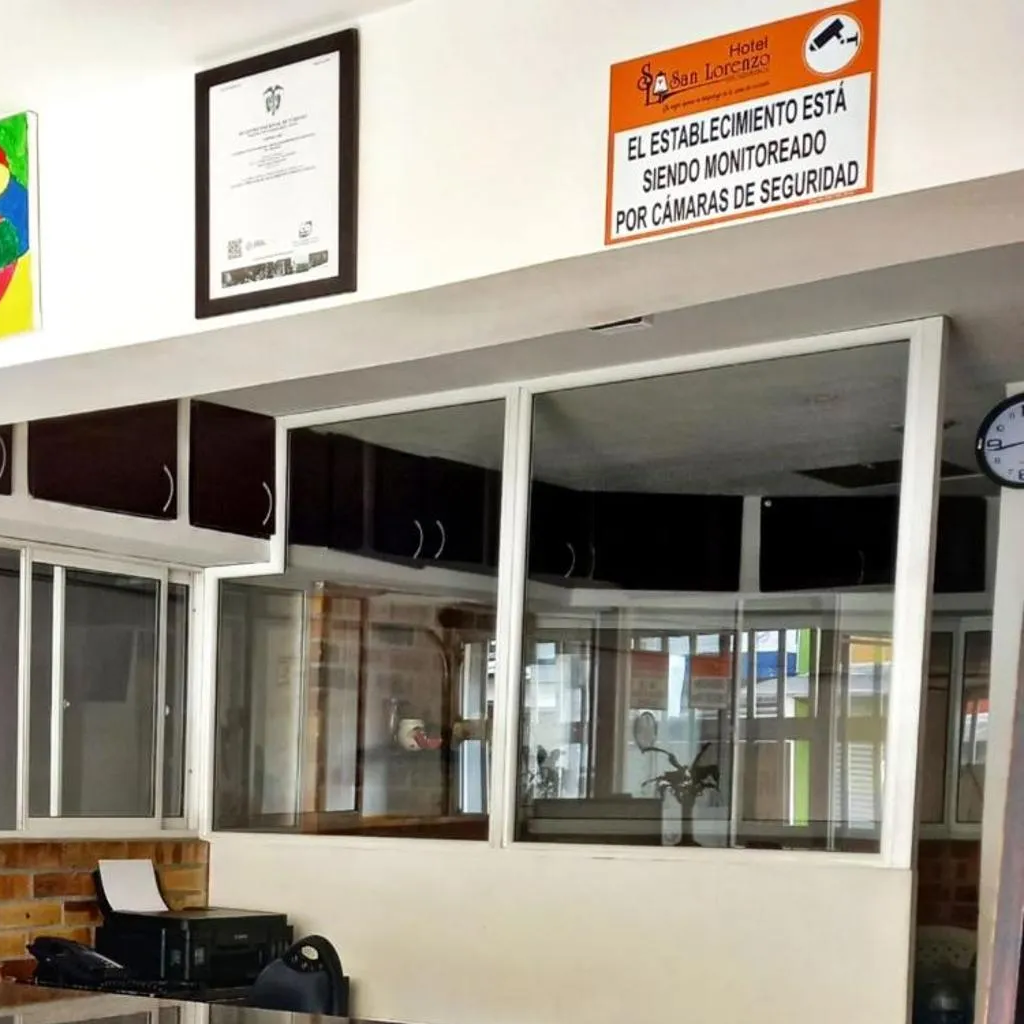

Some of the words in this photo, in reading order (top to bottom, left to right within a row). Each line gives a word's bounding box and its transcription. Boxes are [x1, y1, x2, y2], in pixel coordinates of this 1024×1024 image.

[671, 69, 698, 88] San
[705, 53, 771, 81] Lorenzo
[729, 35, 769, 56] Hotel
[627, 134, 646, 162] EL
[650, 99, 798, 157] ESTABLECIMIENTO
[802, 81, 848, 121] ESTÁ
[642, 158, 700, 194] SIENDO
[704, 129, 827, 180] MONITOREADO
[615, 205, 648, 235] POR
[652, 194, 730, 227] CÁMARAS
[733, 182, 756, 210] DE
[760, 160, 860, 204] SEGURIDAD
